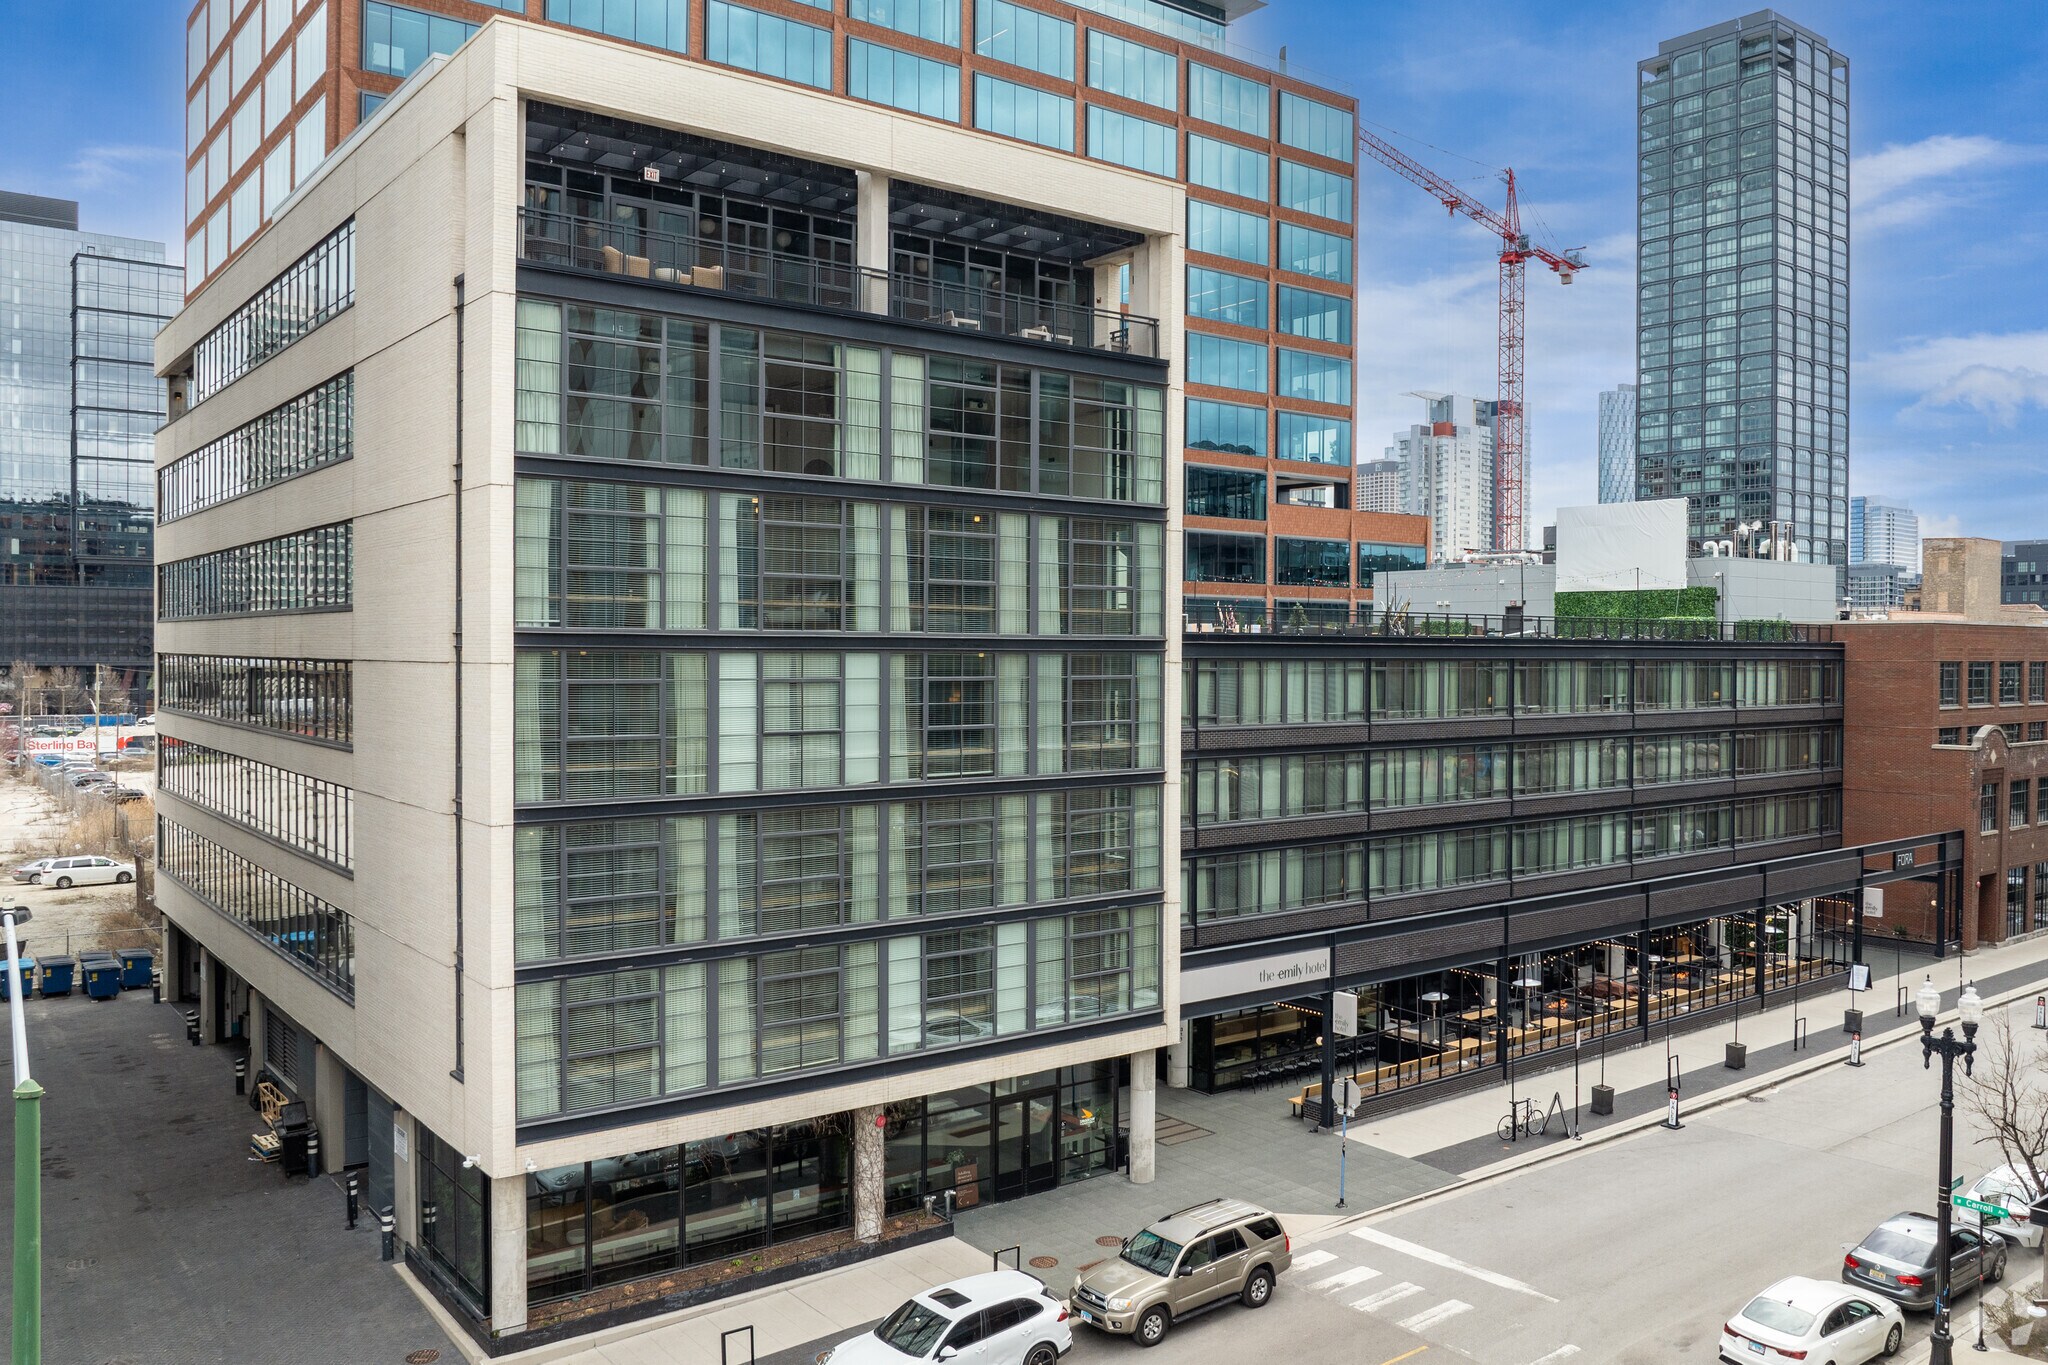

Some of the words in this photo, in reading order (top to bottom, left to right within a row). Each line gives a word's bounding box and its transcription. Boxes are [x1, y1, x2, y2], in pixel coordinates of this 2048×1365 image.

[646, 170, 657, 180] EXIT
[28, 740, 74, 751] Sterling
[77, 740, 97, 750] Bay
[1897, 853, 1913, 866] FORA
[1259, 969, 1275, 983] the
[1277, 963, 1303, 981] emily
[1305, 959, 1328, 974] hotel
[1966, 1200, 1993, 1213] Carroll
